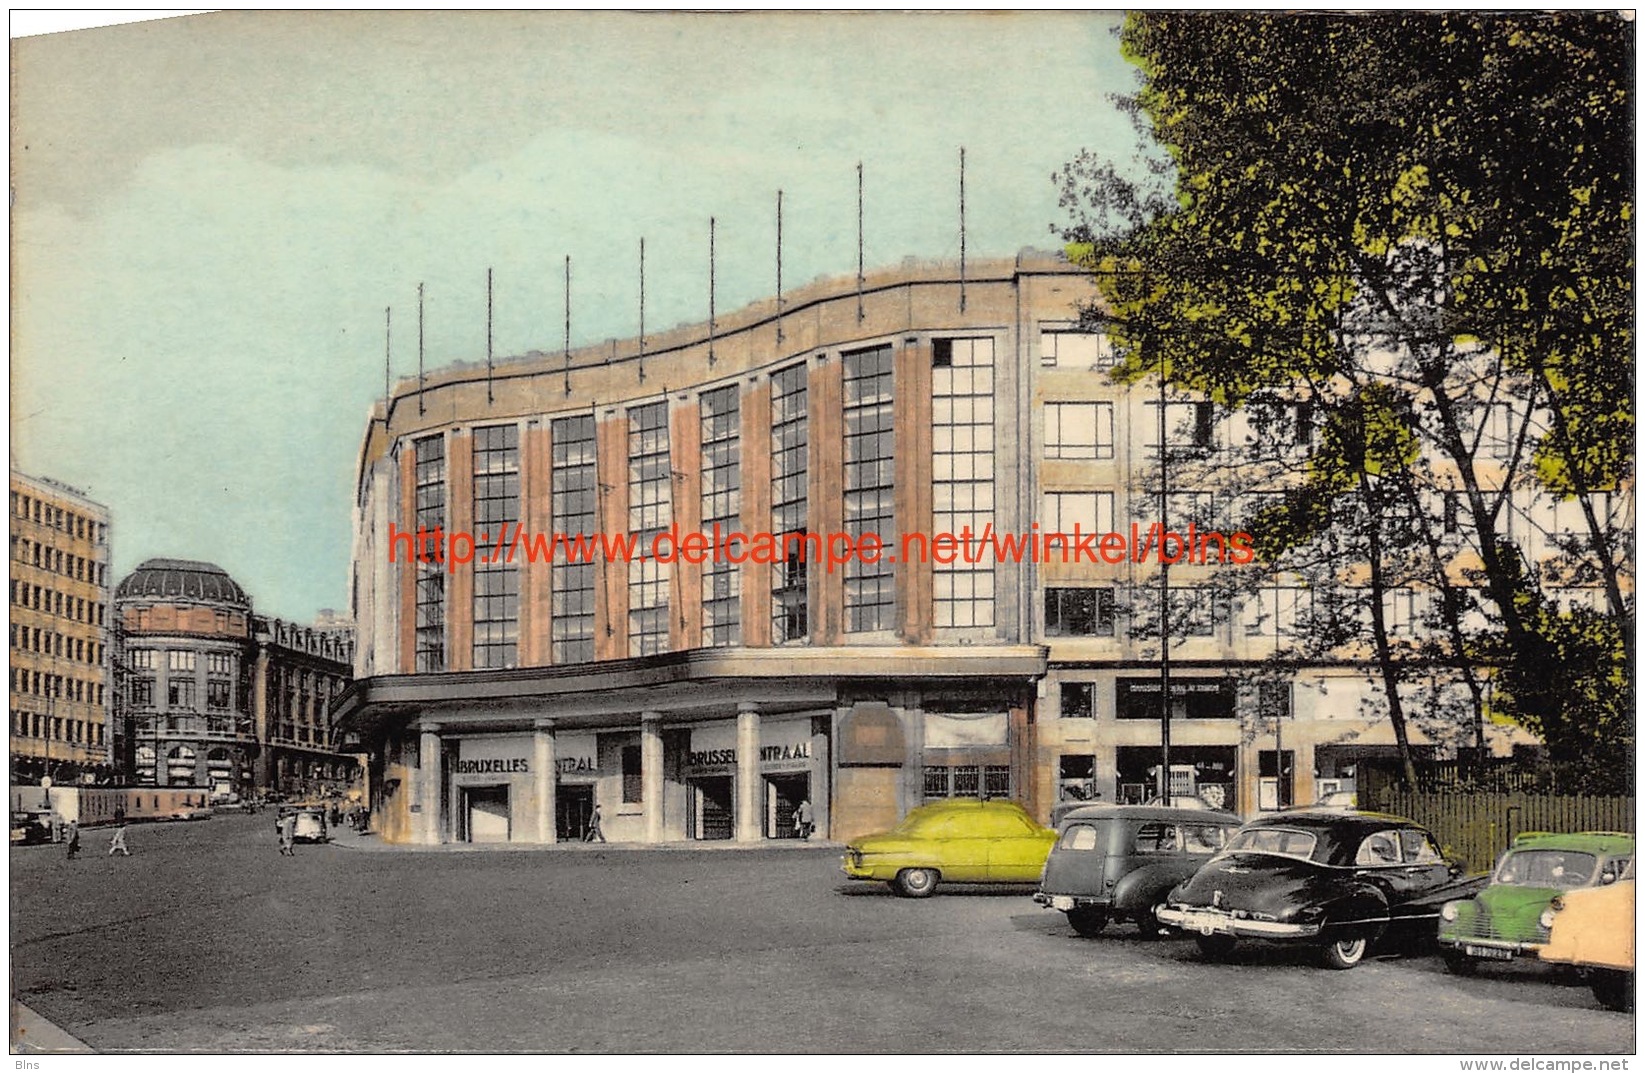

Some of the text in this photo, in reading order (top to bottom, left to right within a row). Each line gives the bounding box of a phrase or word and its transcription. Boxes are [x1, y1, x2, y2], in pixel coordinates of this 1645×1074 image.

[690, 742, 810, 766] BRUSSEL NTRAAL
[458, 757, 597, 775] BRUXELLES NTRAL
